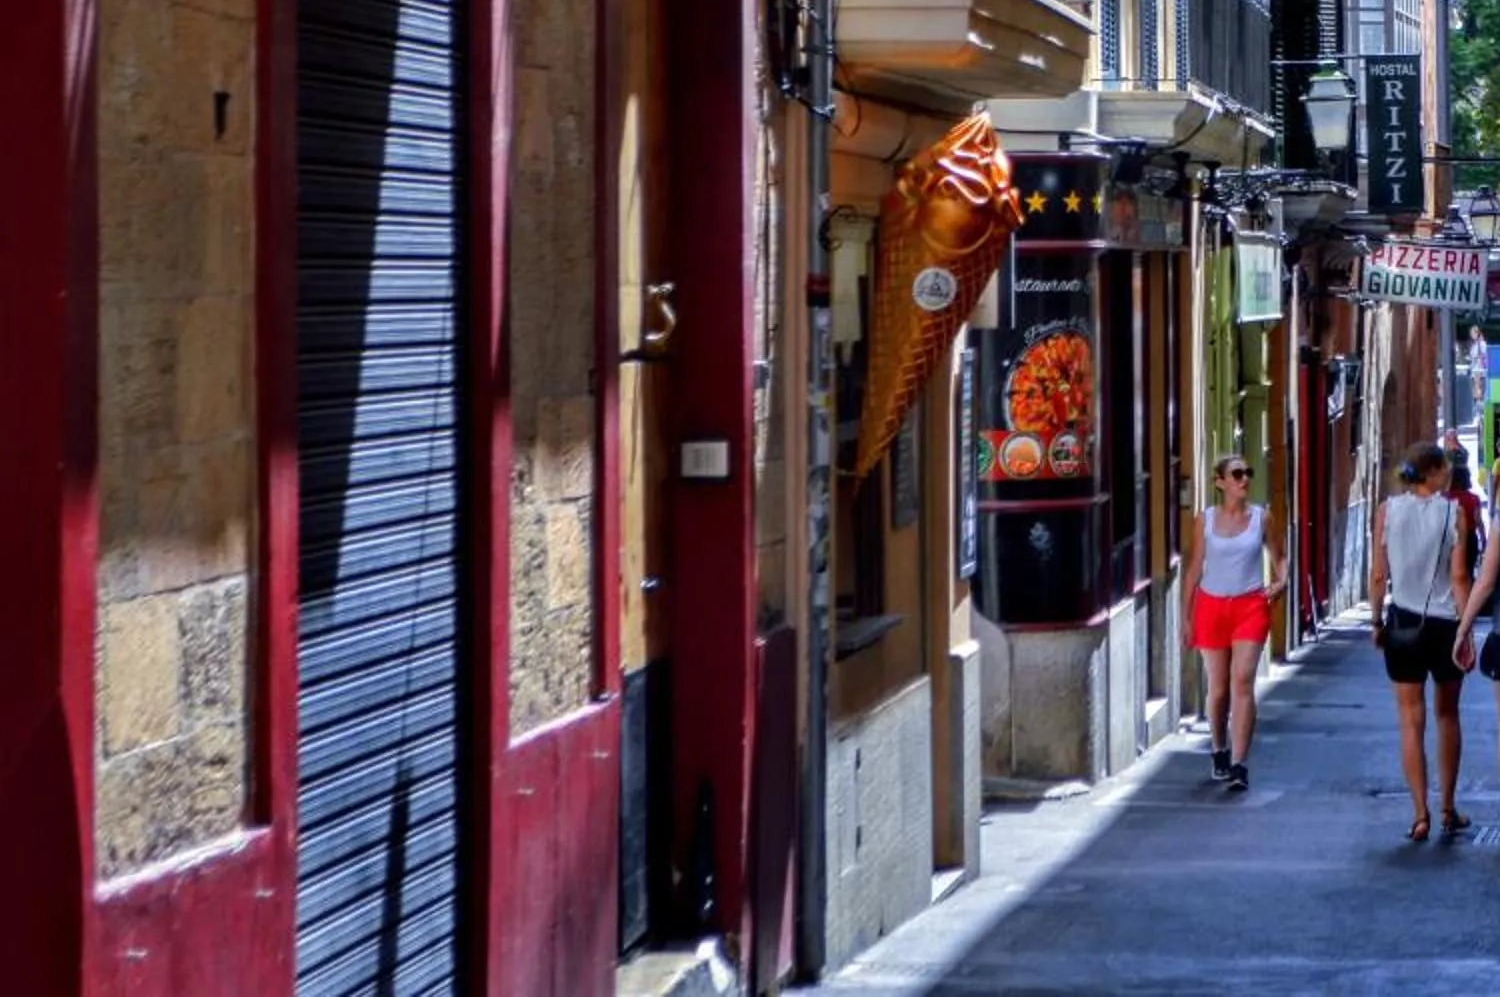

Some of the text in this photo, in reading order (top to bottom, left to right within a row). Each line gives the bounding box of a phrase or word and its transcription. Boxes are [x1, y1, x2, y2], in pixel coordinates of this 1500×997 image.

[1369, 64, 1417, 77] HOSTAL
[1382, 79, 1407, 204] RITZI
[1371, 246, 1481, 275] PIZZERIA
[1367, 272, 1481, 304] GIOVANINI
